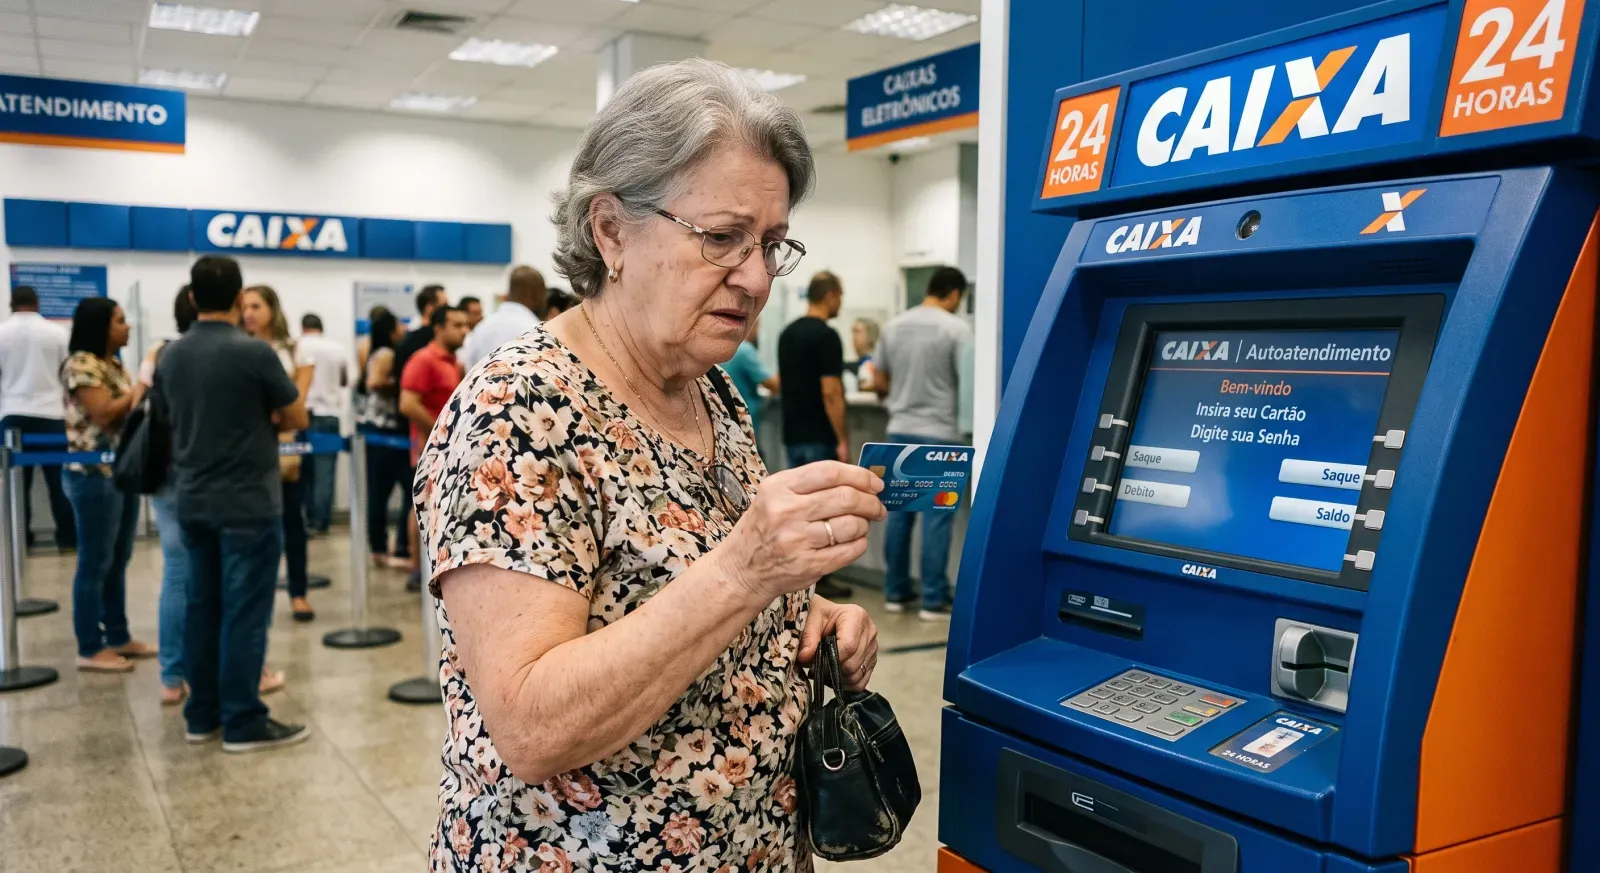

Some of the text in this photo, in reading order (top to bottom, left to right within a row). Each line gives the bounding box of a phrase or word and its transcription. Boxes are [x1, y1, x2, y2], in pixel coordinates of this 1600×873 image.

[1458, 0, 1566, 85] 24
[883, 63, 937, 96] CAIXAS
[861, 85, 961, 128] ELETRÔNICOS
[1136, 32, 1411, 168] CAIXA
[1452, 77, 1555, 118] HORAS
[1053, 102, 1108, 163] 24
[1048, 161, 1099, 186] HORAS
[207, 212, 348, 252] CAIXA
[1105, 215, 1202, 255] CAIXA
[1161, 340, 1391, 362] CAIXA Autoatendimento
[1220, 379, 1292, 396] Bem-vindo
[1196, 402, 1306, 422] Insira seu Cartão
[1190, 424, 1300, 446] Digite sua Senha
[925, 450, 968, 462] CAIXA
[1132, 450, 1162, 467] Saque
[1322, 468, 1361, 486] Saque
[1124, 484, 1155, 498] Debito
[1316, 507, 1351, 524] Saldo
[1182, 563, 1217, 579] CAIXA
[1275, 717, 1323, 735] CAIXA
[1221, 749, 1271, 769] 24 HORAS
